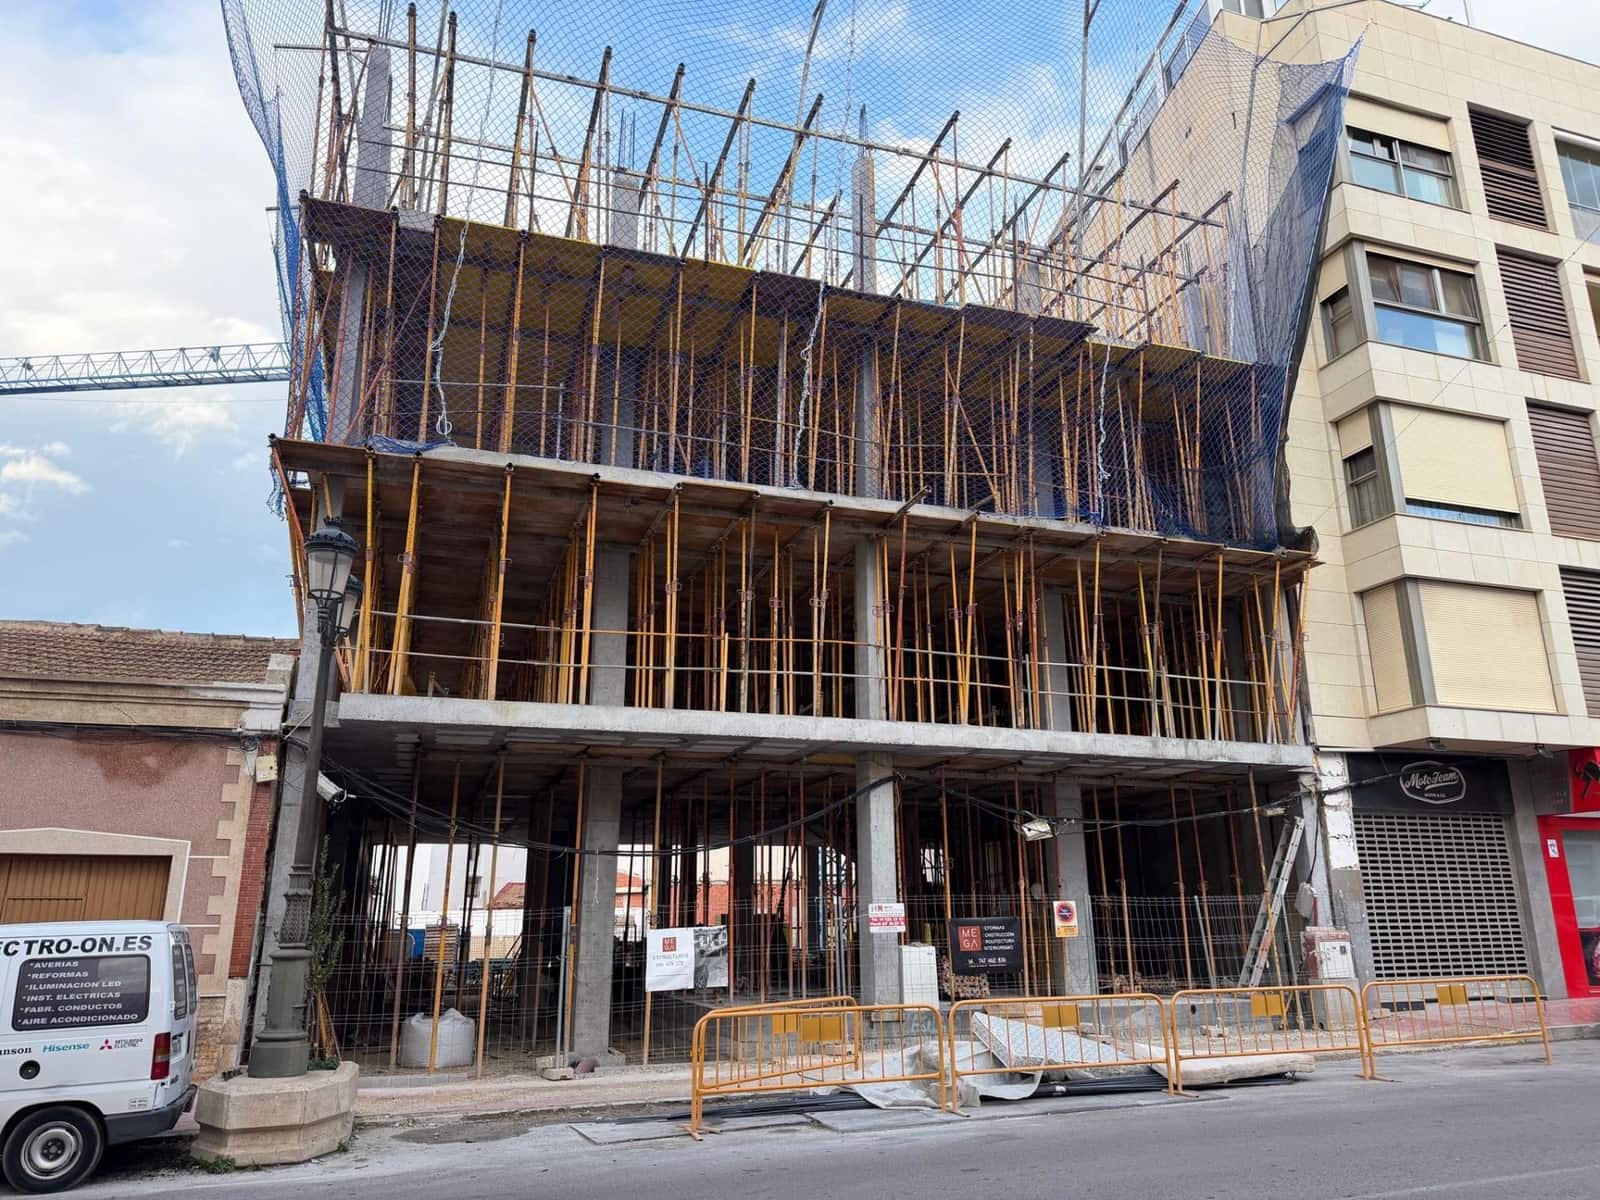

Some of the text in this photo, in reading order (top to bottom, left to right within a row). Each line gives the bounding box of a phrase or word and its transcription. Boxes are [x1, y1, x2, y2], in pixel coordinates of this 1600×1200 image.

[34, 961, 79, 969] AVERIAS
[32, 971, 89, 979] REFORMAS
[29, 980, 121, 990] ILUMINACION LED
[26, 992, 121, 1002] INST. ELECTRICAS
[58, 1003, 122, 1012] CONDUCTOS
[22, 1013, 138, 1025] AIRE ACONDICIONADO
[43, 1043, 90, 1053] Hisense
